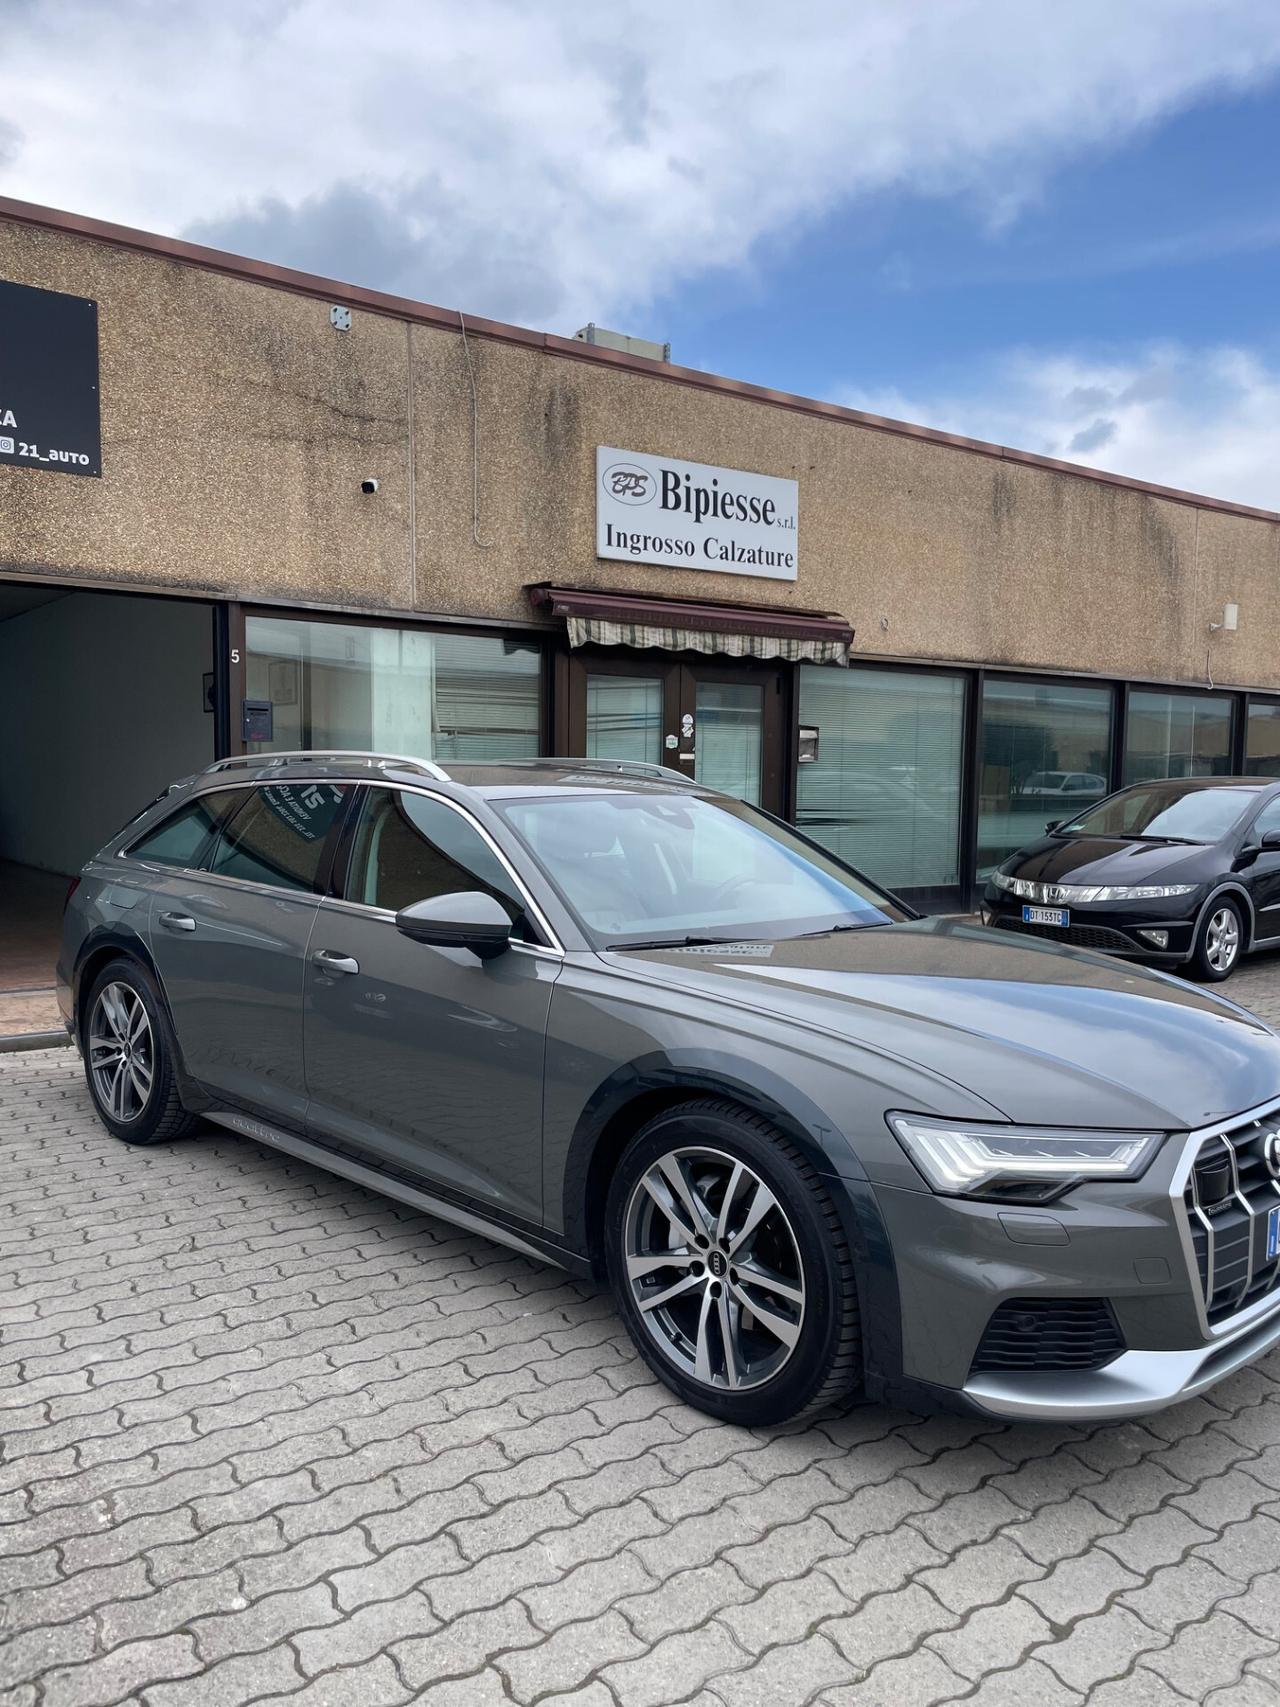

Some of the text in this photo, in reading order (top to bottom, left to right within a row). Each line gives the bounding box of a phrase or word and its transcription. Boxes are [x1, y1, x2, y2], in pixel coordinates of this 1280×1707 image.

[660, 469, 796, 530] Bipiesse s.r.l.
[605, 523, 794, 568] Ingrosso Calzature
[231, 649, 240, 663] 5
